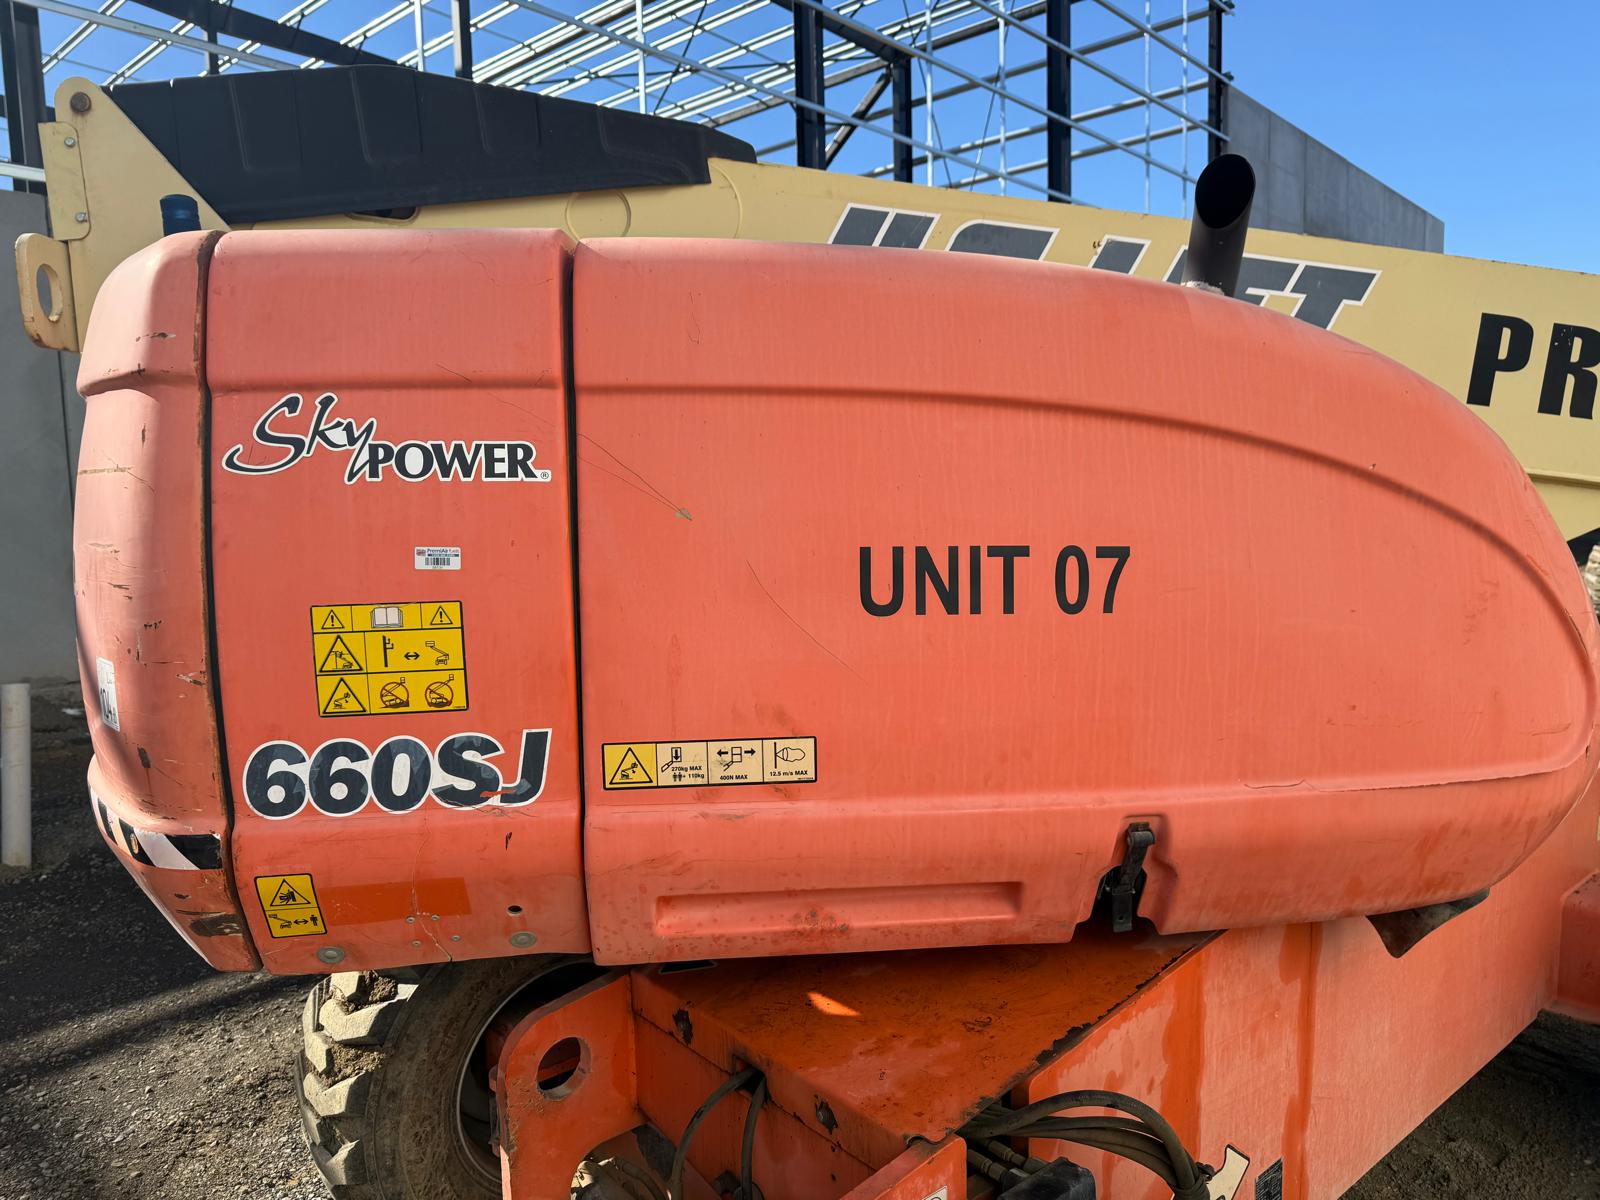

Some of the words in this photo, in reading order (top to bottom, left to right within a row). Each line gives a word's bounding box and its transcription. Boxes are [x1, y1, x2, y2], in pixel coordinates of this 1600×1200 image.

[1466, 312, 1600, 420] PR
[859, 545, 1030, 617] UNIT
[1055, 545, 1131, 615] 07
[243, 728, 552, 820] 660SJ
